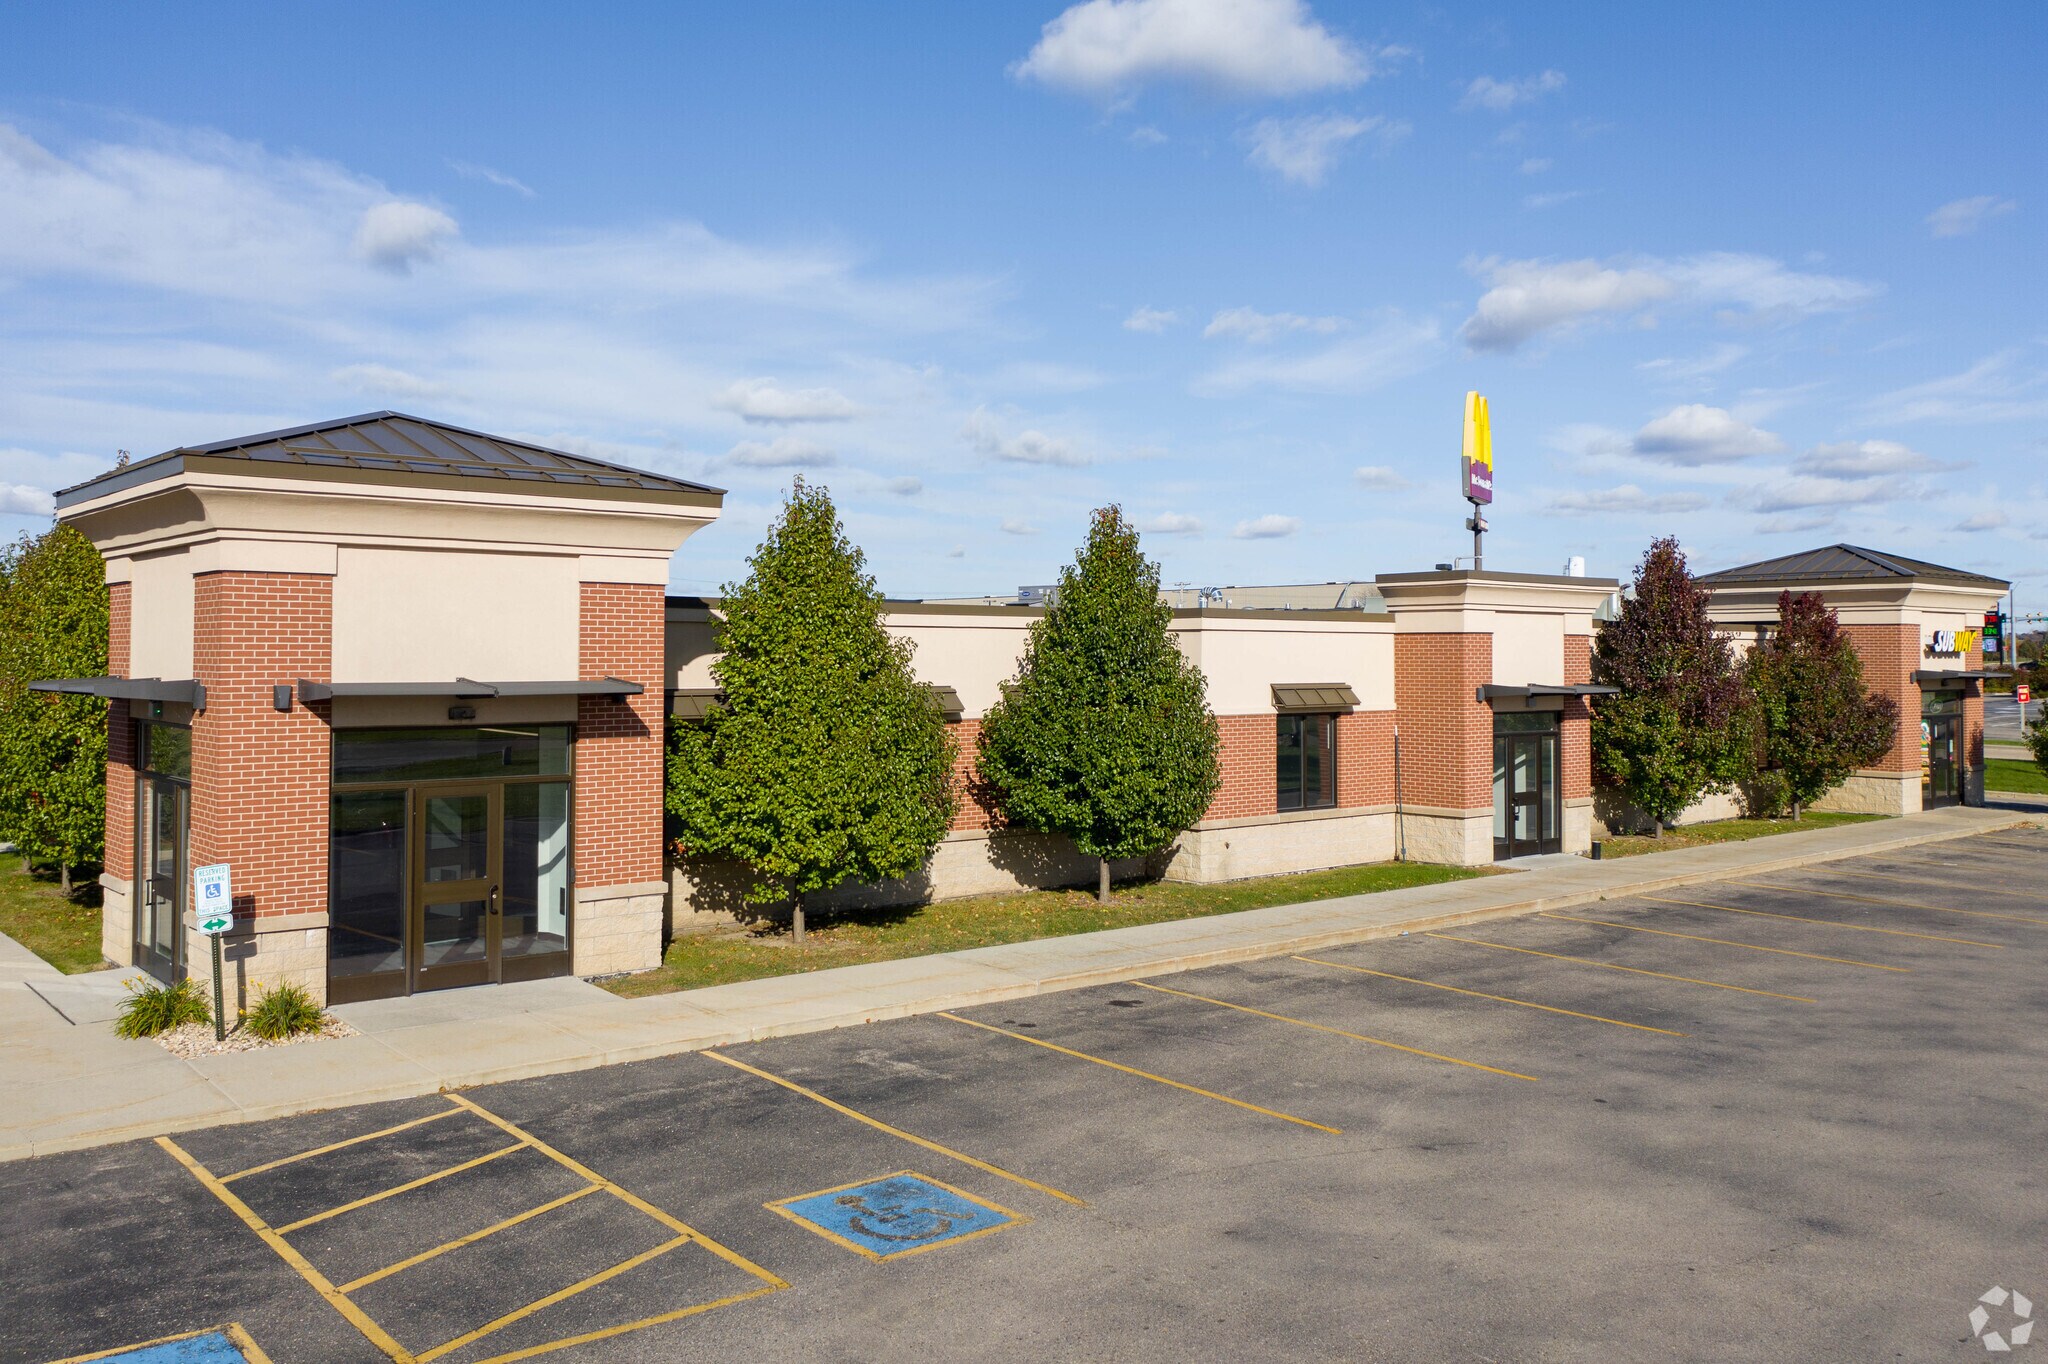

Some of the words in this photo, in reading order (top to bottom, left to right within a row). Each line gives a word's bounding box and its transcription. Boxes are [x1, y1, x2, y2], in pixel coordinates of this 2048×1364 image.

[1934, 630, 1977, 652] SUBWAY
[198, 867, 226, 876] RESERVED
[200, 875, 225, 884] PARKING
